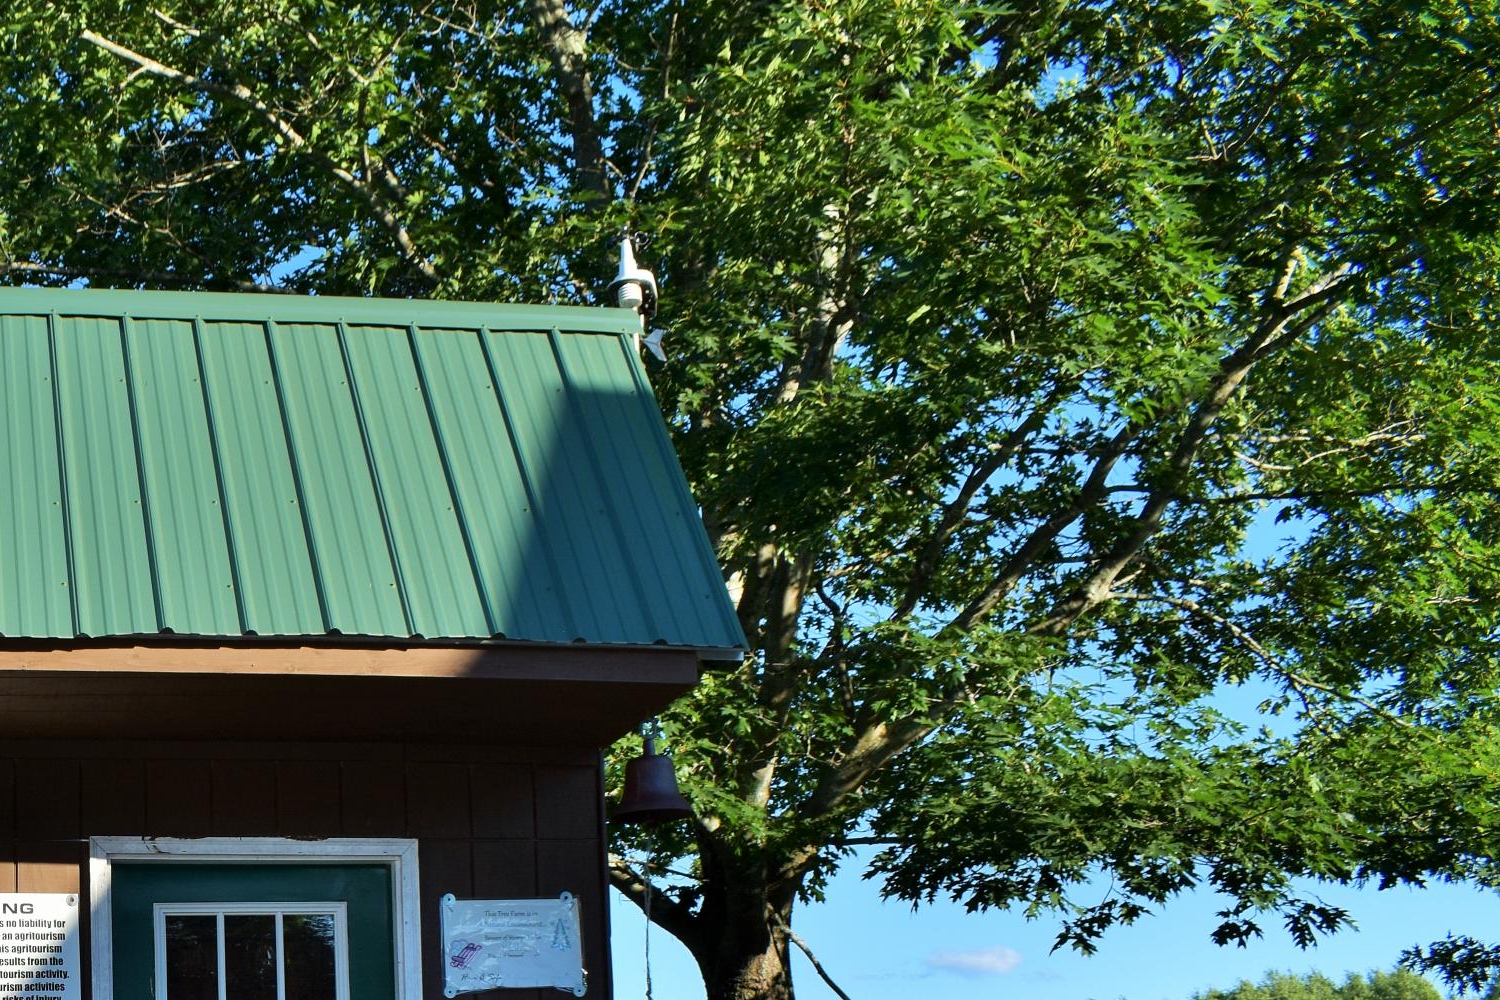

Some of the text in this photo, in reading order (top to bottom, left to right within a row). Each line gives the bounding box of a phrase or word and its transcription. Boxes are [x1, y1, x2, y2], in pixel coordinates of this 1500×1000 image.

[19, 919, 51, 929] liability
[54, 919, 65, 928] for
[15, 932, 65, 942] agritourism
[11, 945, 62, 954] agritourism
[27, 957, 48, 966] from
[49, 957, 63, 965] the
[36, 970, 69, 979] activity.
[25, 983, 65, 991] activities
